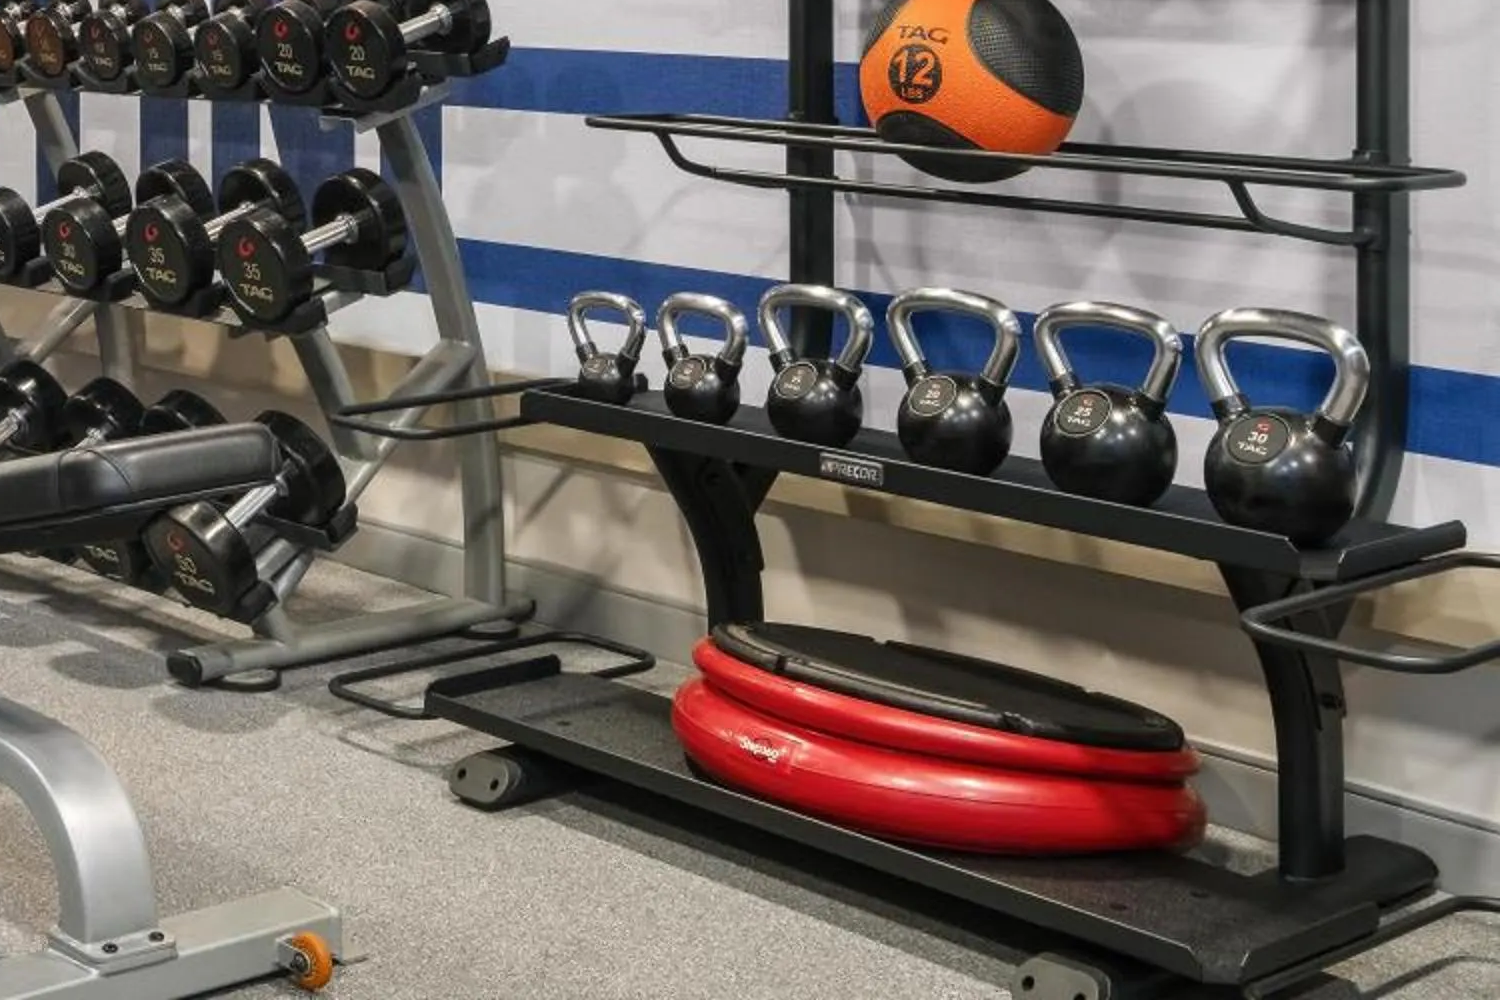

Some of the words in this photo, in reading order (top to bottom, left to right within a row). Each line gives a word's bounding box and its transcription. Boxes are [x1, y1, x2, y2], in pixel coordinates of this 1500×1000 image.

[897, 24, 951, 45] TAG
[277, 44, 293, 58] 20
[349, 46, 365, 61] 20
[274, 61, 303, 76] TAG
[346, 65, 375, 79] TAG
[894, 50, 934, 86] 12
[149, 247, 165, 263] 35
[145, 267, 177, 284] TAG
[243, 262, 261, 281] 35
[239, 283, 273, 301] TAG
[1248, 432, 1269, 444] 30
[1238, 441, 1269, 456] TAG
